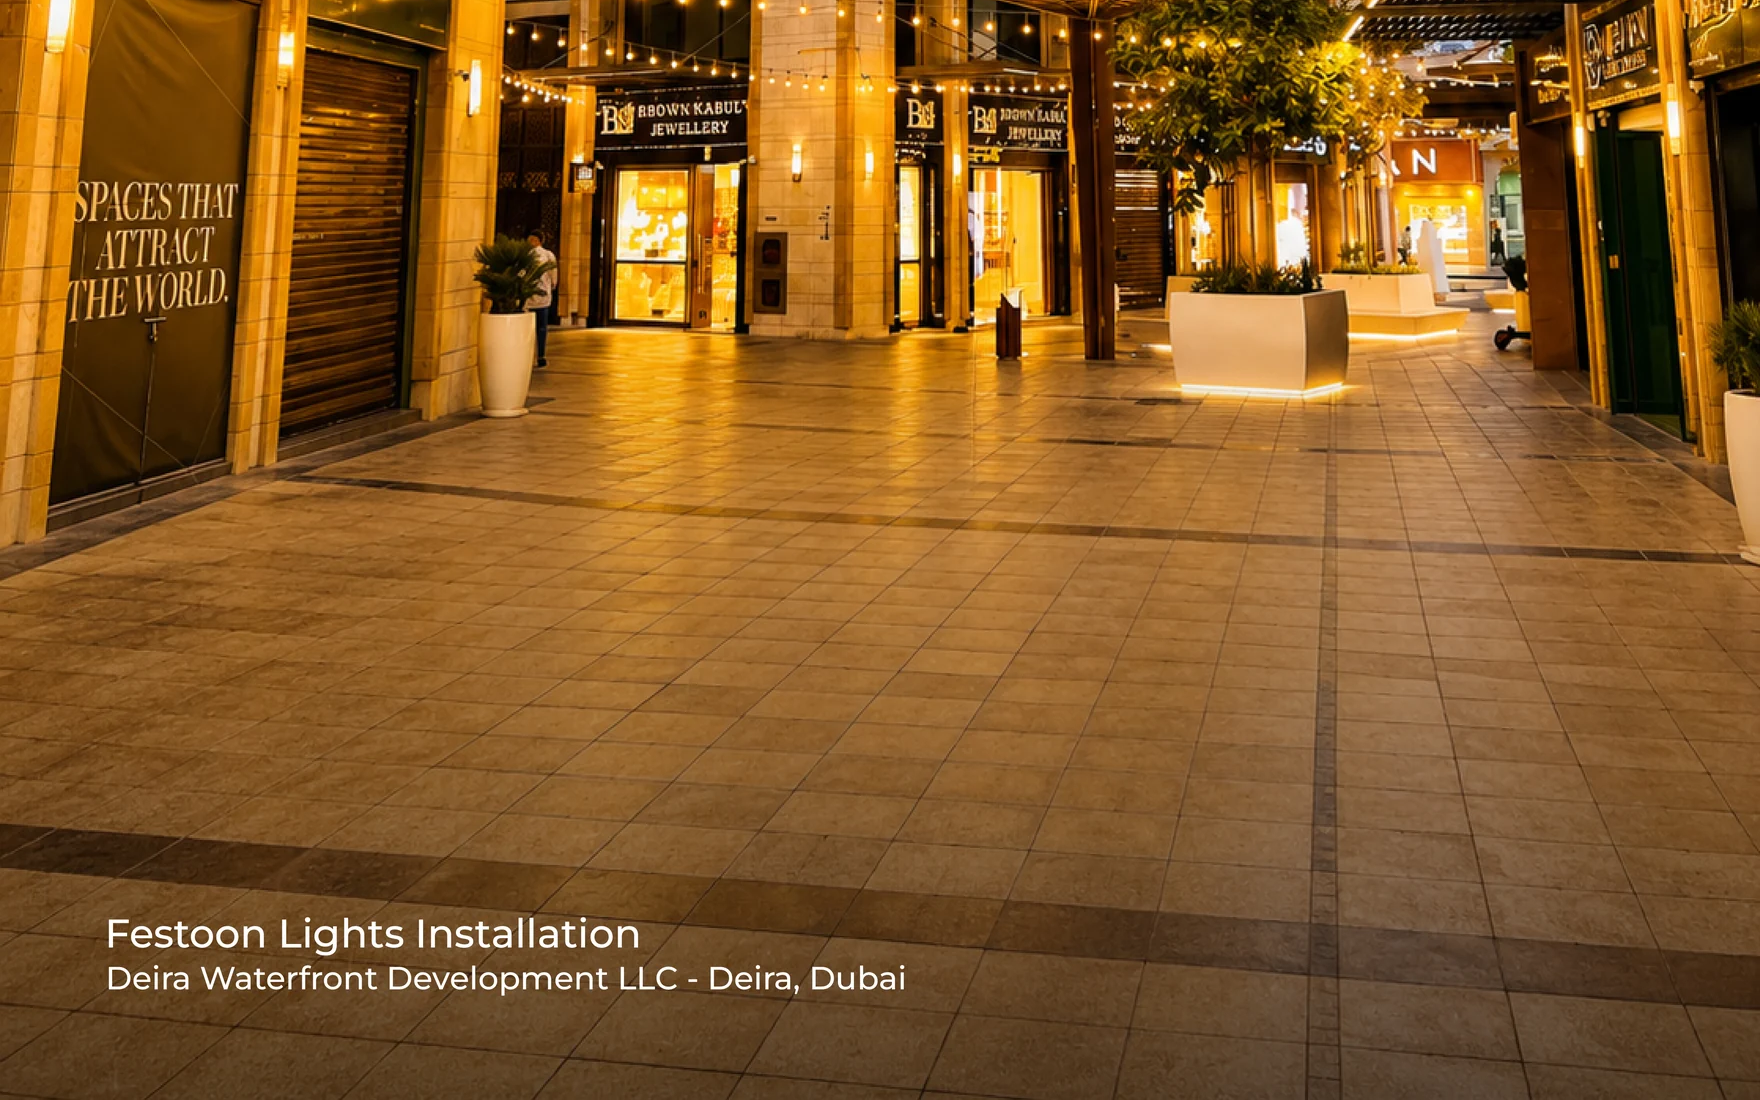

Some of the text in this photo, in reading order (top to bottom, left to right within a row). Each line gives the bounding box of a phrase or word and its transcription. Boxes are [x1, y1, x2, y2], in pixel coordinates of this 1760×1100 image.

[650, 120, 730, 137] JEWELLERY
[74, 181, 239, 223] SPACES THAT
[95, 226, 215, 271] ATTRACT
[68, 276, 129, 323] THE
